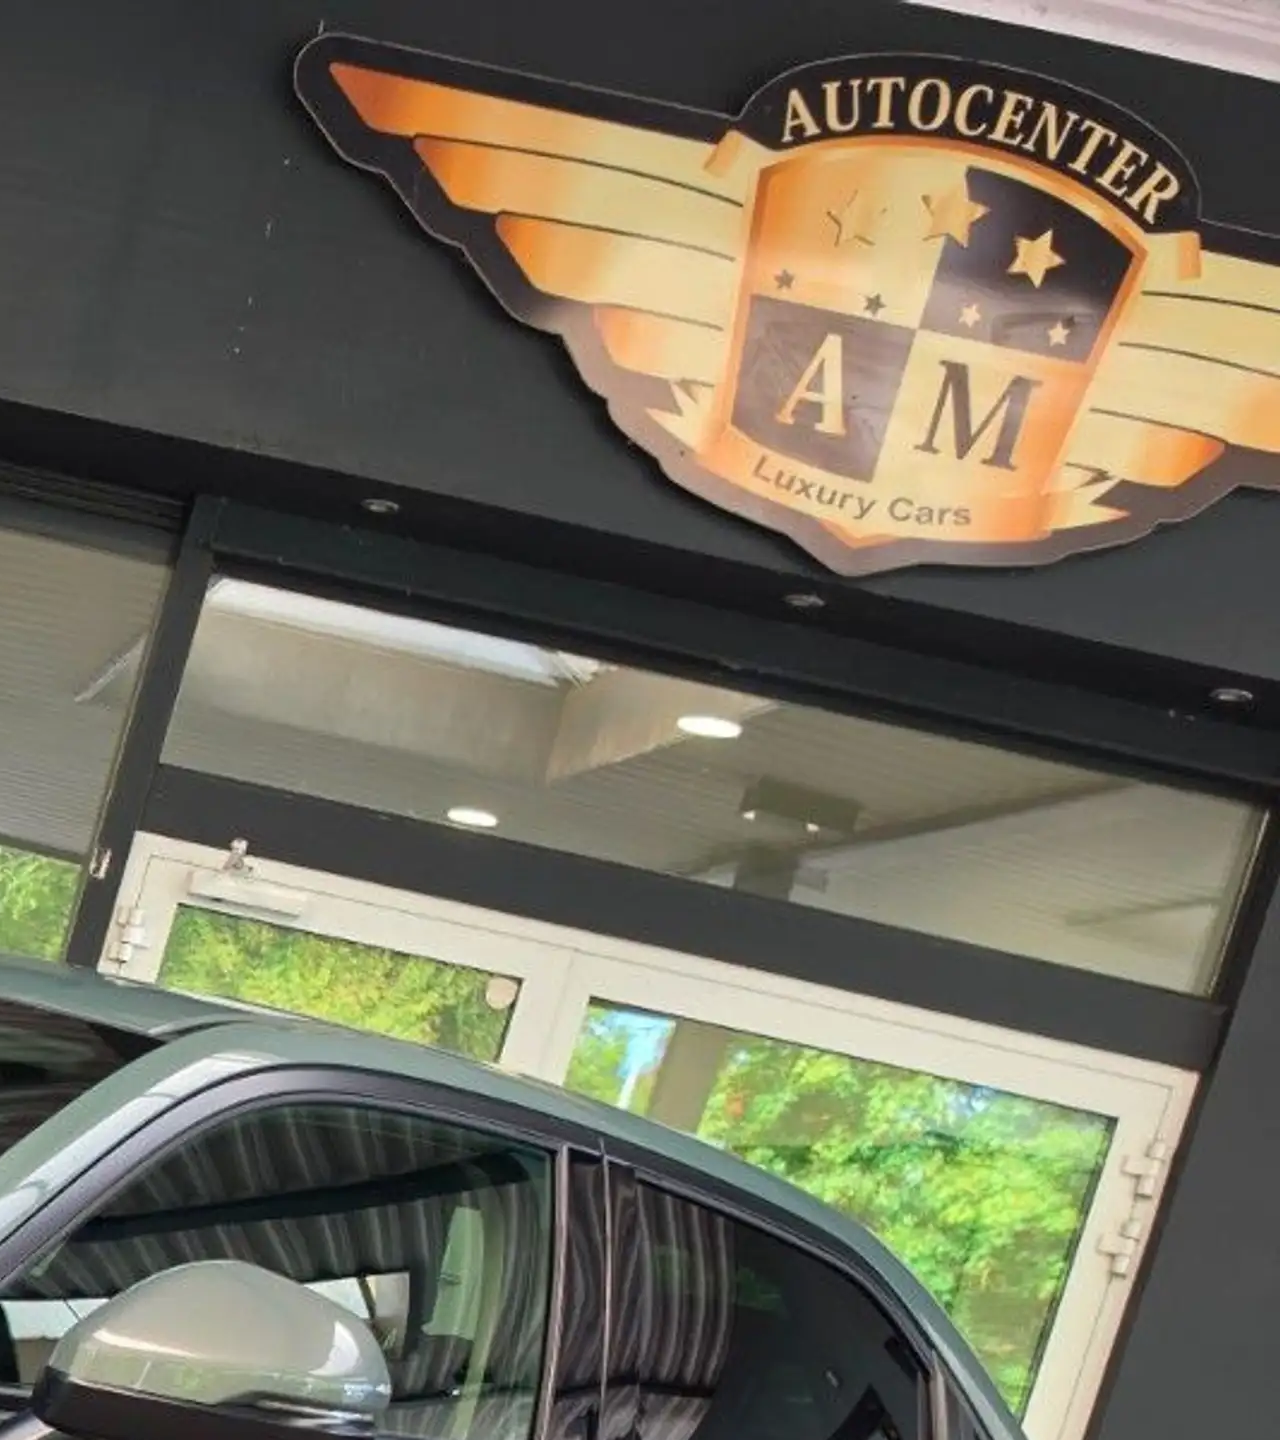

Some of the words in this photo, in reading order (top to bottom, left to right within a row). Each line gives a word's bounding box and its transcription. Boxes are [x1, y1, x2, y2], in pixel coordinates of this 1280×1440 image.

[780, 76, 1180, 225] AUTOCENTER
[776, 333, 846, 436] A
[912, 359, 1044, 471] M
[751, 455, 877, 520] Luxury
[887, 497, 972, 526] Cars
